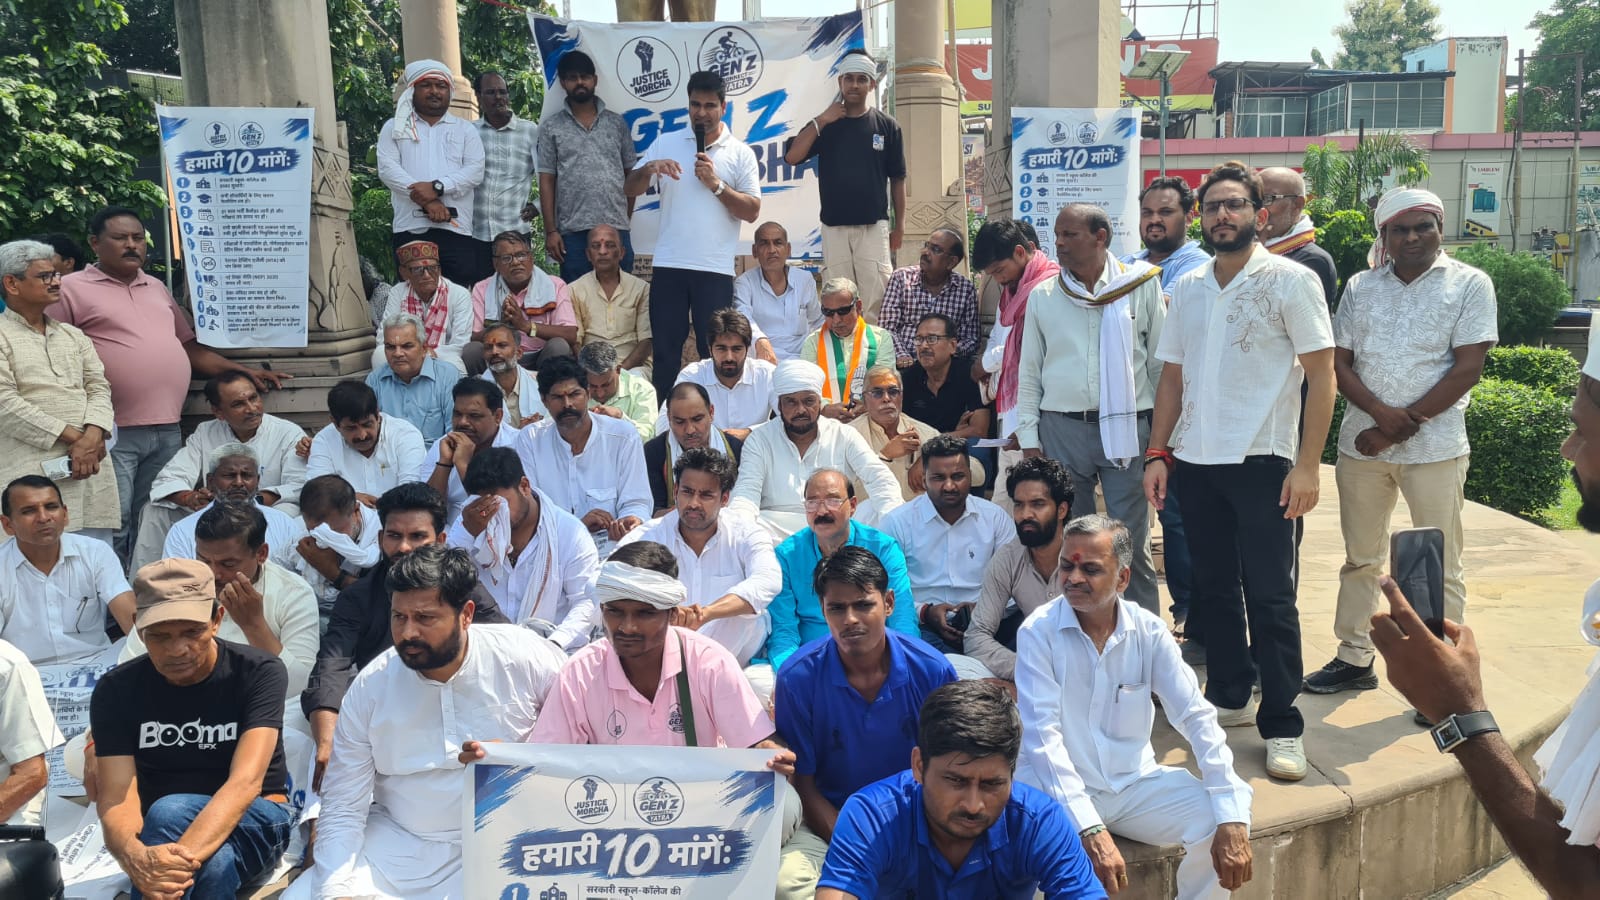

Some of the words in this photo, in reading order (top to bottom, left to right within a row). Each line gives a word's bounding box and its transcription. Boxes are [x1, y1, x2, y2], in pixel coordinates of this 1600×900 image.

[709, 58, 742, 78] GEN
[746, 55, 757, 70] Z
[630, 68, 668, 88] JUSTICE
[725, 73, 748, 82] ONNECT
[634, 79, 672, 96] MORCHA
[744, 88, 790, 144] Z
[184, 152, 224, 171] हमारी
[227, 151, 254, 173] 10
[1029, 150, 1062, 167] हमारी
[1064, 149, 1088, 169] 10
[574, 799, 608, 810] JUSTICE
[576, 806, 609, 816] MORCHA
[640, 800, 667, 811] GEN
[669, 799, 679, 809] Z
[521, 832, 601, 871] हमारी
[604, 832, 661, 877] 10
[668, 834, 732, 866] मांगें:
[587, 884, 616, 894] सरकारी
[618, 886, 668, 896] स्कूल-कॉलेज
[670, 886, 681, 895] की
